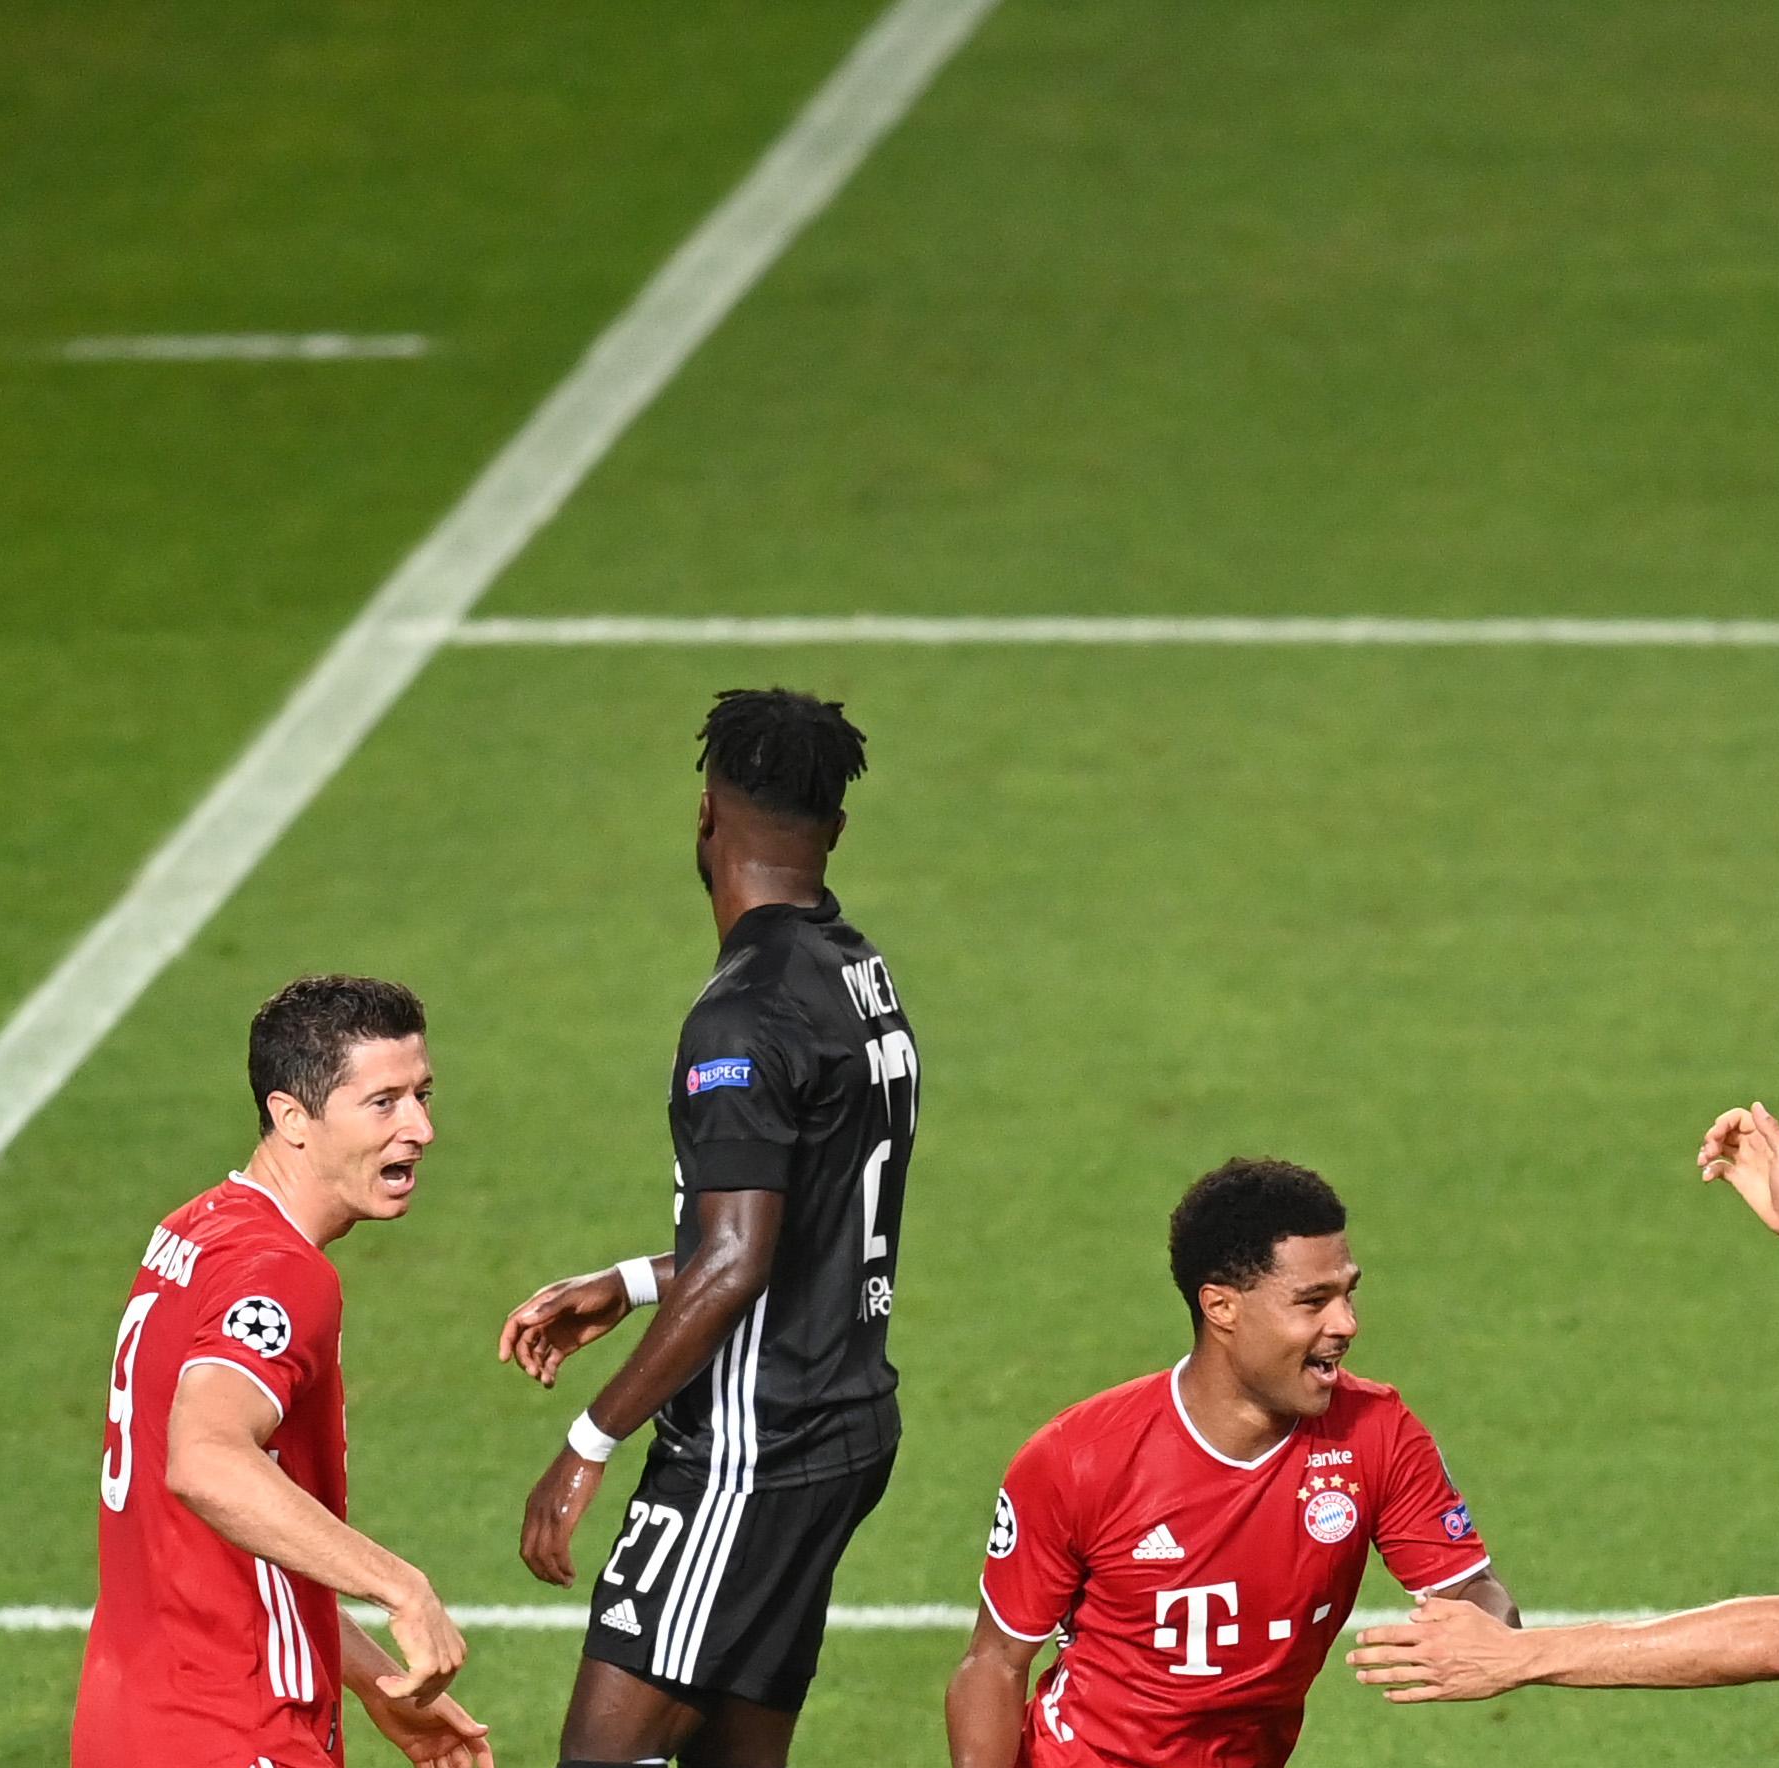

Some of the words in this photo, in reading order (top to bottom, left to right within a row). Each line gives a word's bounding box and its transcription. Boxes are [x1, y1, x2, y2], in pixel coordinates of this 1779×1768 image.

[699, 1065, 751, 1084] RESPECT
[868, 1275, 893, 1297] OL
[603, 1500, 684, 1594] 27
[1131, 1546, 1186, 1560] adidas
